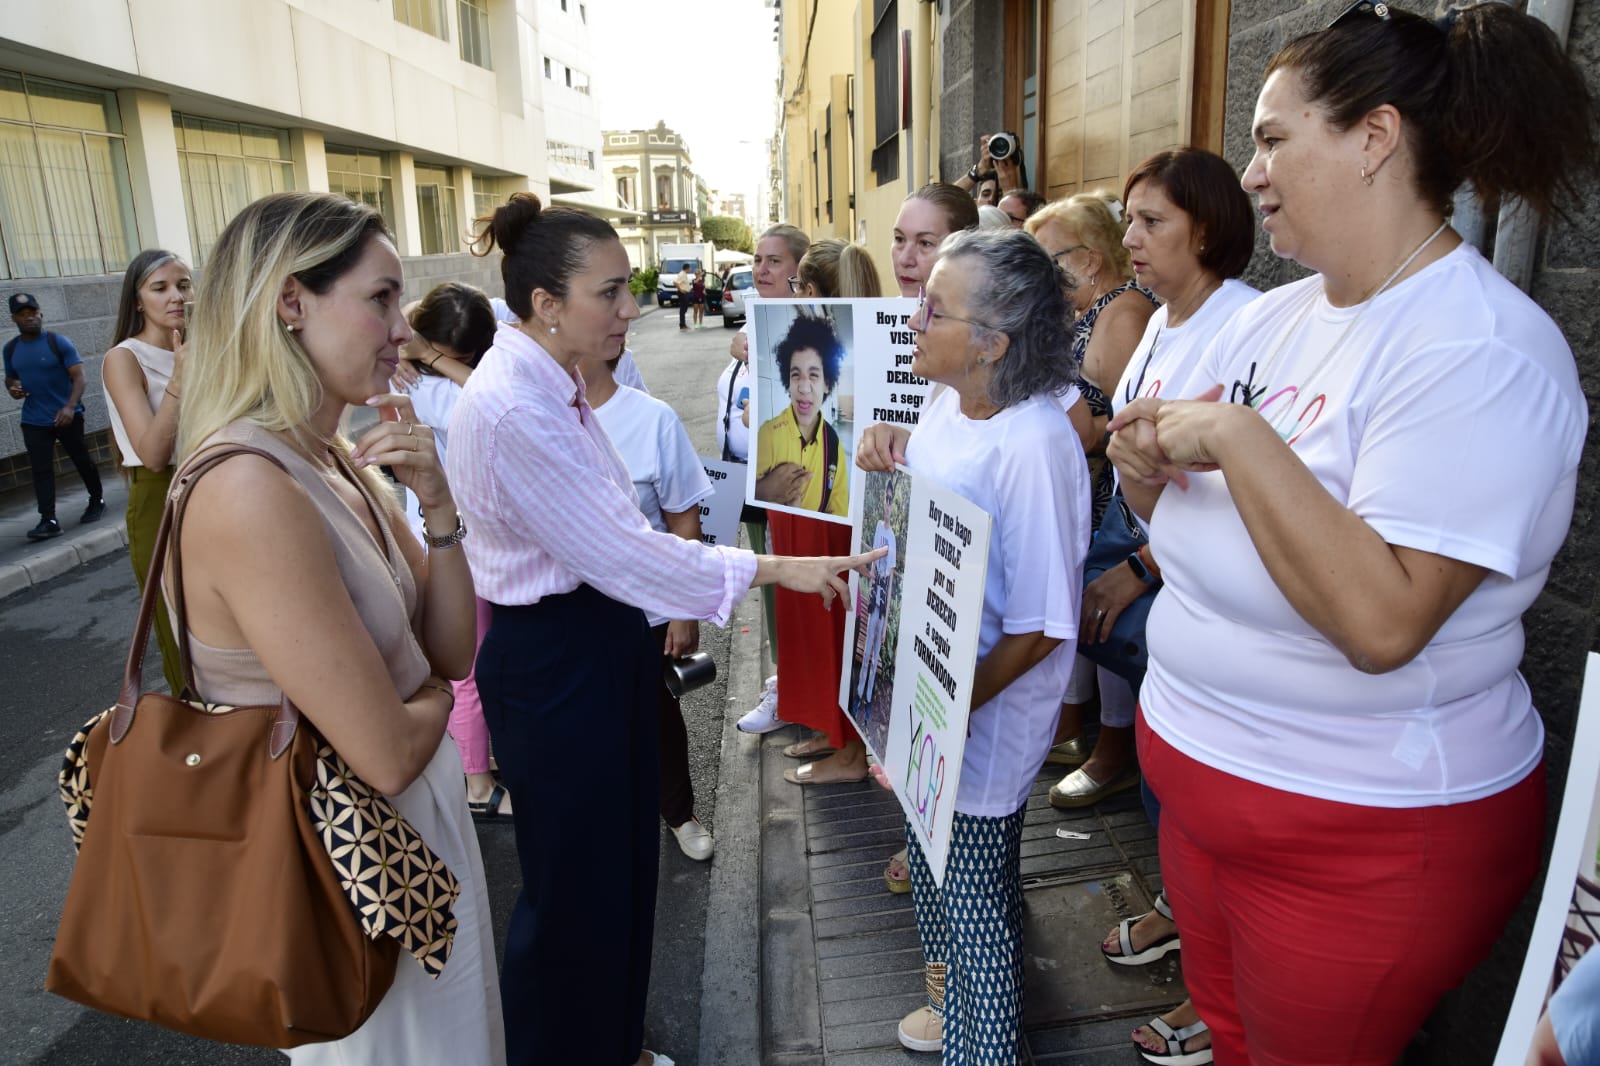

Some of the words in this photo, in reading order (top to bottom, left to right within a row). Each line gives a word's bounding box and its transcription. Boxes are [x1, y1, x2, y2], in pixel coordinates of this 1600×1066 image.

[876, 312, 897, 327] Hoy
[901, 315, 911, 325] m
[890, 332, 917, 345] VISI
[895, 354, 914, 367] por
[890, 393, 897, 403] a
[873, 408, 920, 425] FORMÁN
[928, 499, 942, 529] Hoy
[942, 512, 954, 532] me
[955, 516, 972, 548] hago
[934, 533, 962, 571] VISIBLE
[933, 568, 946, 588] por
[946, 576, 956, 598] mi
[926, 588, 957, 633] DERECHO
[925, 621, 931, 636] a
[931, 628, 951, 660] seguir
[913, 634, 958, 702] FORMÁNDOME
